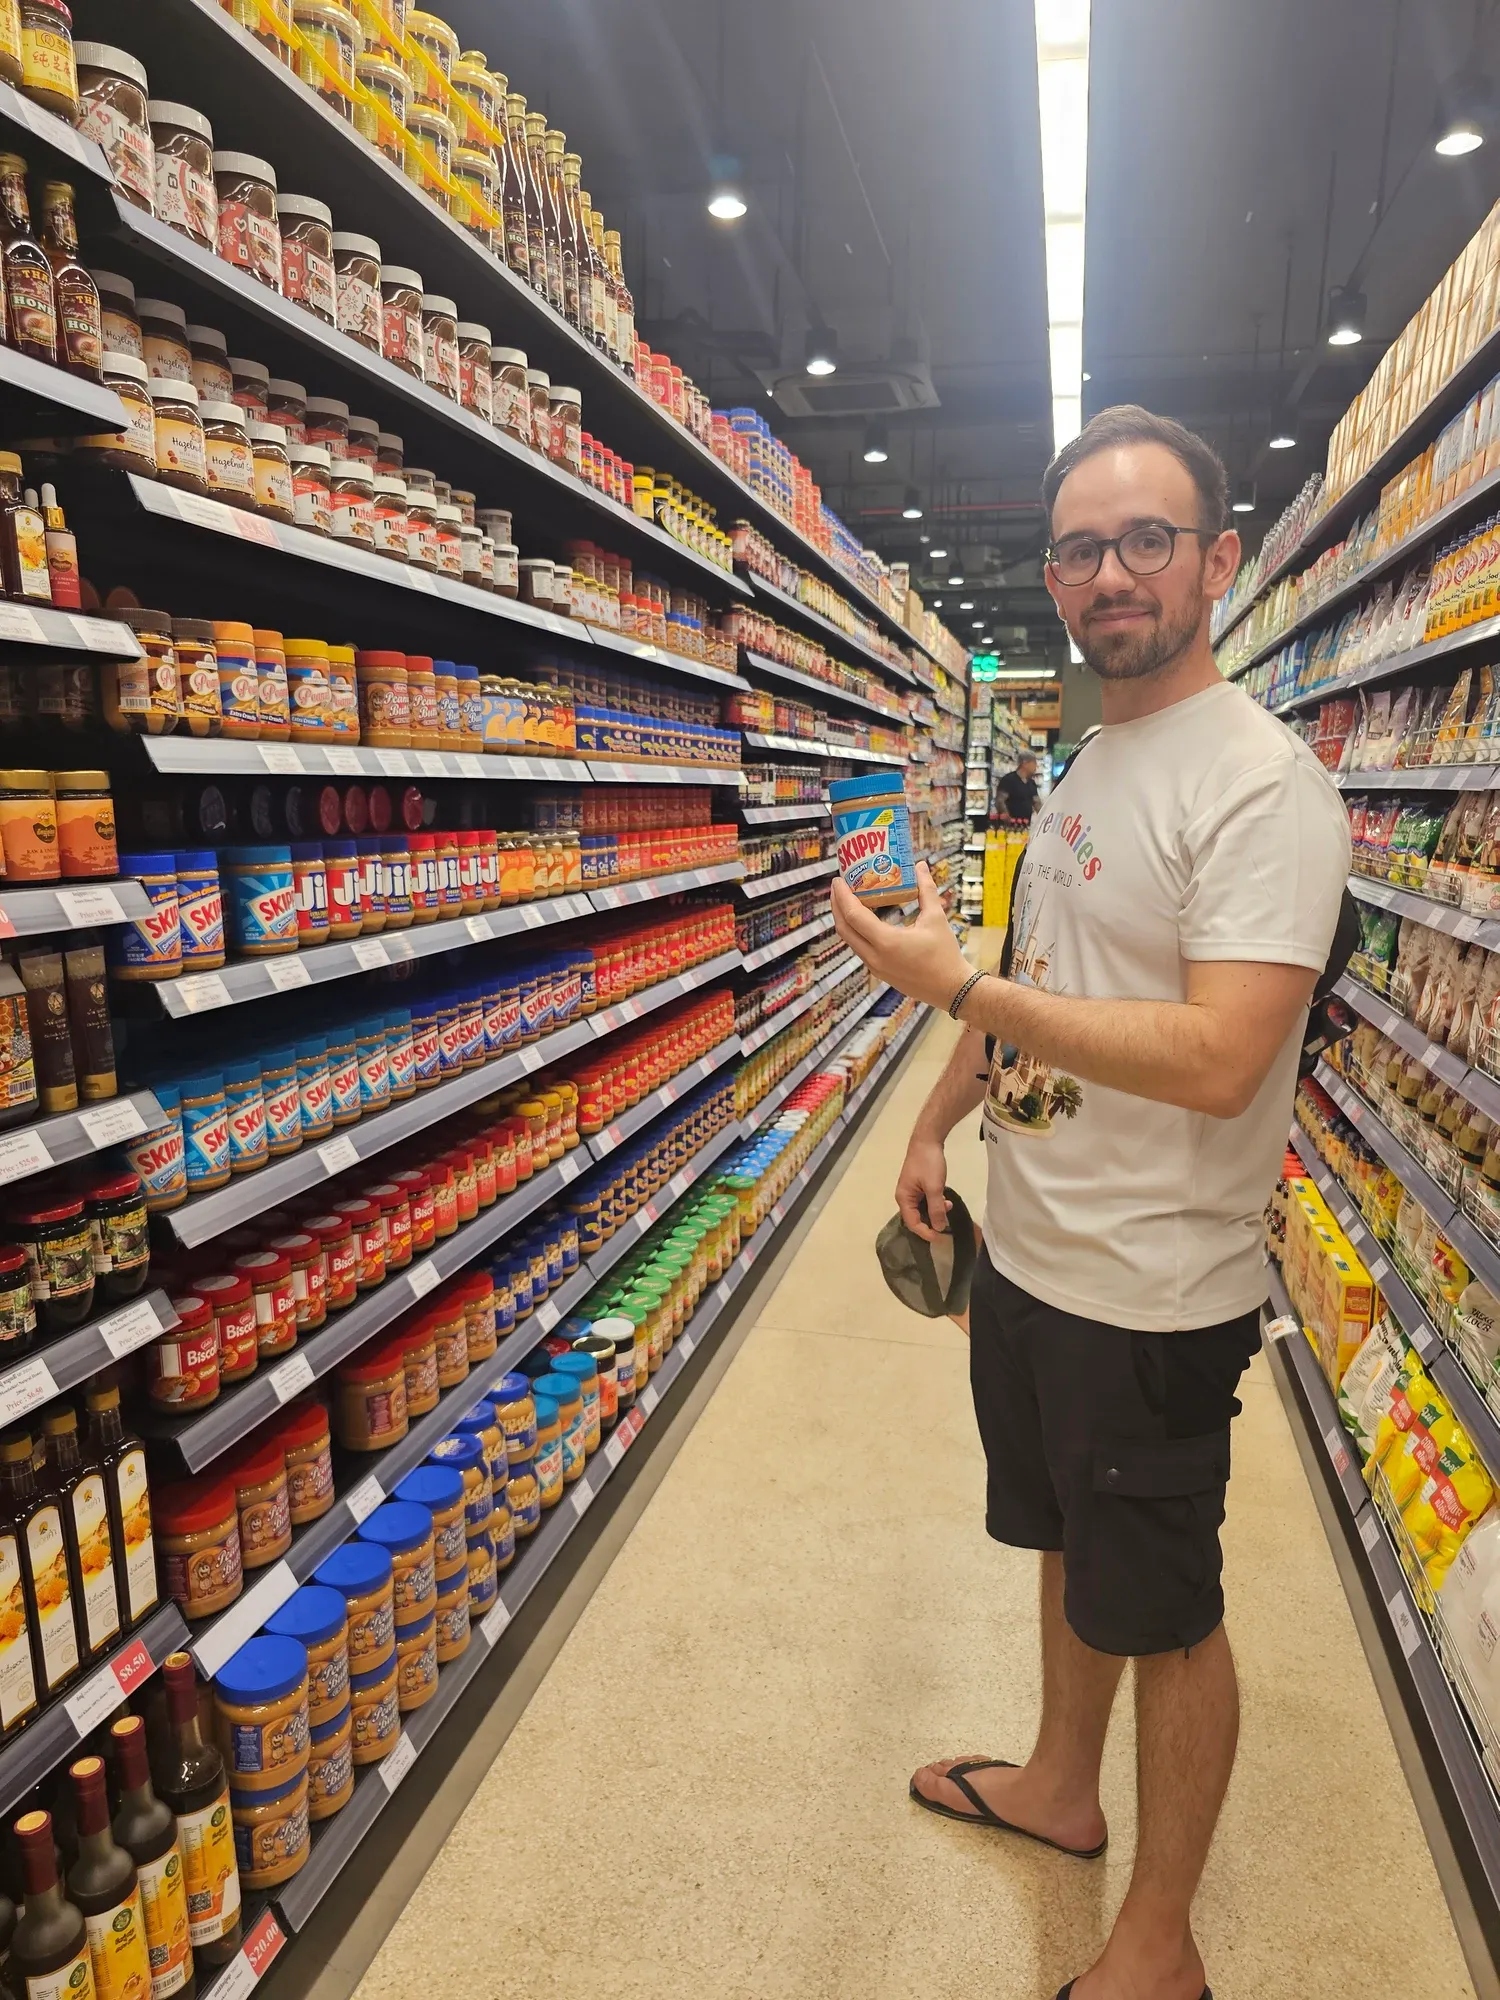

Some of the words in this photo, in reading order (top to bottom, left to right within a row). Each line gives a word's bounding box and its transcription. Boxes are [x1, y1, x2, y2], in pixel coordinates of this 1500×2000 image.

[118, 126, 152, 156] nutel
[253, 221, 276, 243] nute
[22, 269, 49, 283] THA
[13, 295, 56, 318] HONE
[68, 320, 100, 340] HON
[311, 492, 331, 511] nute
[348, 504, 374, 522] nutel
[383, 518, 407, 535] nute
[837, 830, 886, 873] SKIPPY
[1036, 813, 1102, 881] renchies
[360, 861, 383, 896] Ji
[412, 861, 437, 893] Ji
[437, 858, 458, 890] Ji
[461, 856, 481, 886] Ji
[482, 854, 499, 884] Ji
[1037, 864, 1051, 880] THE
[1053, 868, 1073, 888] WORLD
[294, 873, 327, 911] Ji
[333, 870, 360, 906] Ji
[145, 904, 178, 940] SKIP
[190, 897, 222, 932] SKIP
[259, 890, 294, 923] SKIP
[233, 1105, 265, 1139] SKIP
[269, 1089, 300, 1123] SKIP
[203, 1121, 229, 1153] SKI
[137, 1135, 183, 1176] SKIPP
[6, 1398, 24, 1412] Price
[119, 1651, 146, 1683] $8.50
[249, 1920, 279, 1968] $20.00
